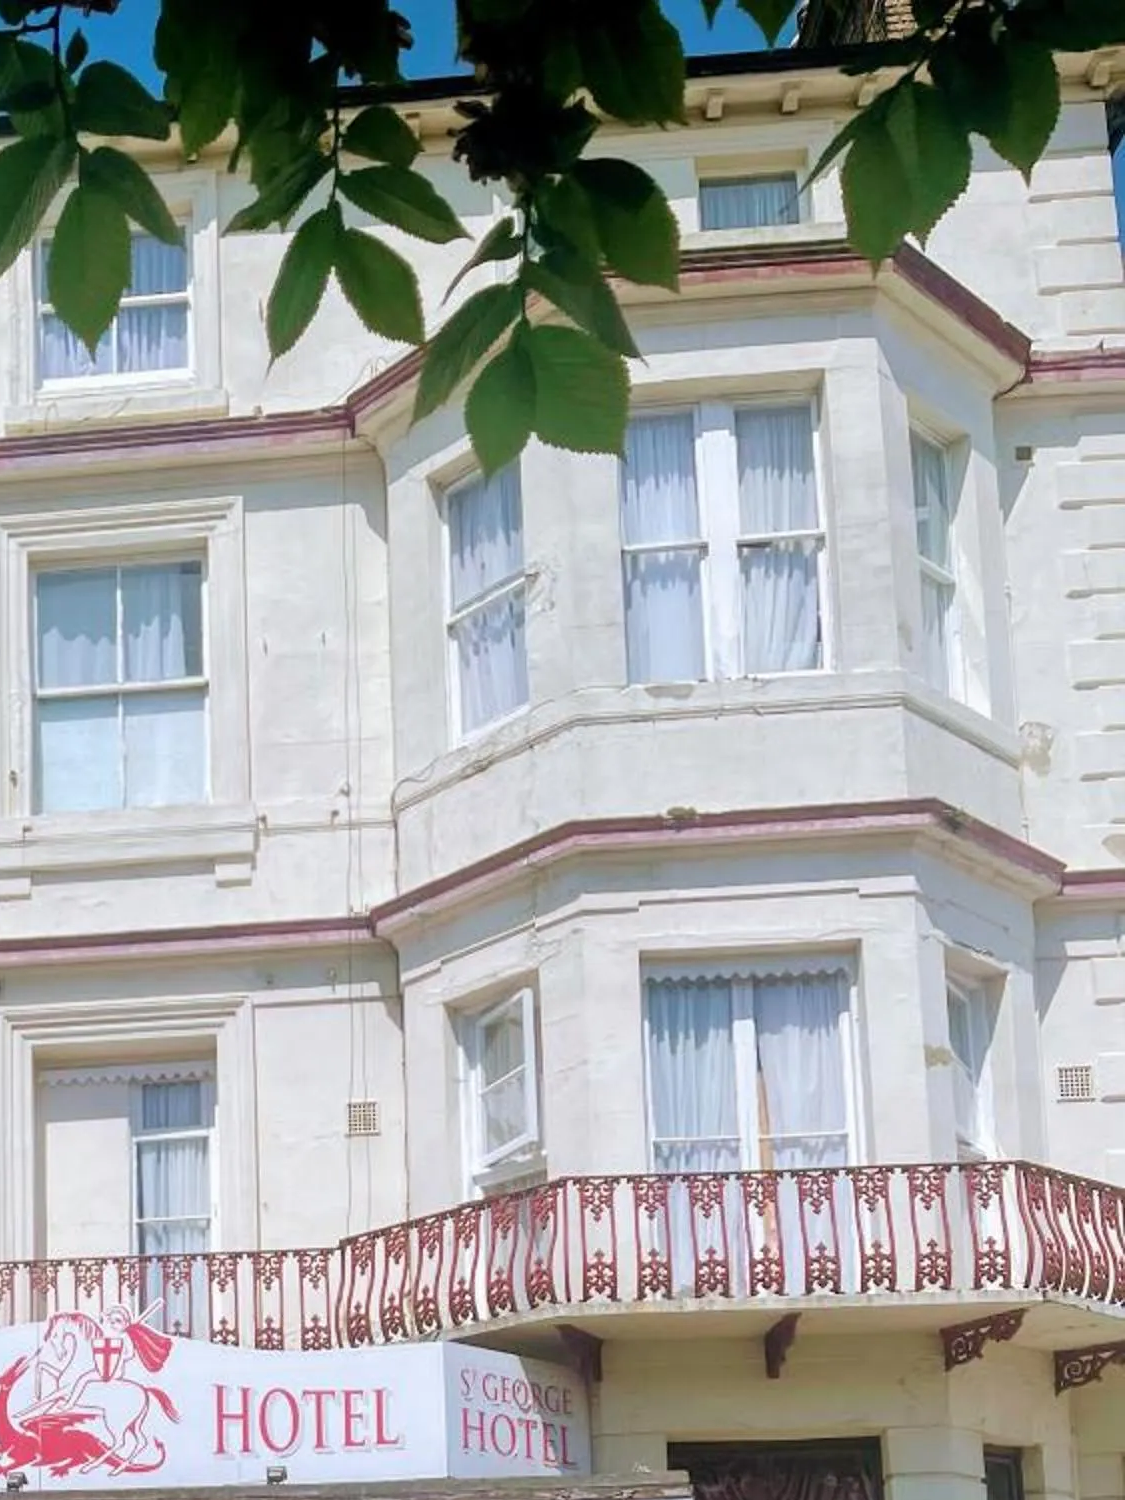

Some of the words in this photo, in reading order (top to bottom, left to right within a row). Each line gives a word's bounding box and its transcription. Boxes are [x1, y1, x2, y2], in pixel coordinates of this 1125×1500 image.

[213, 1383, 400, 1455] HOTEL
[482, 1373, 573, 1415] GEORGE
[461, 1407, 578, 1465] HOTEL
